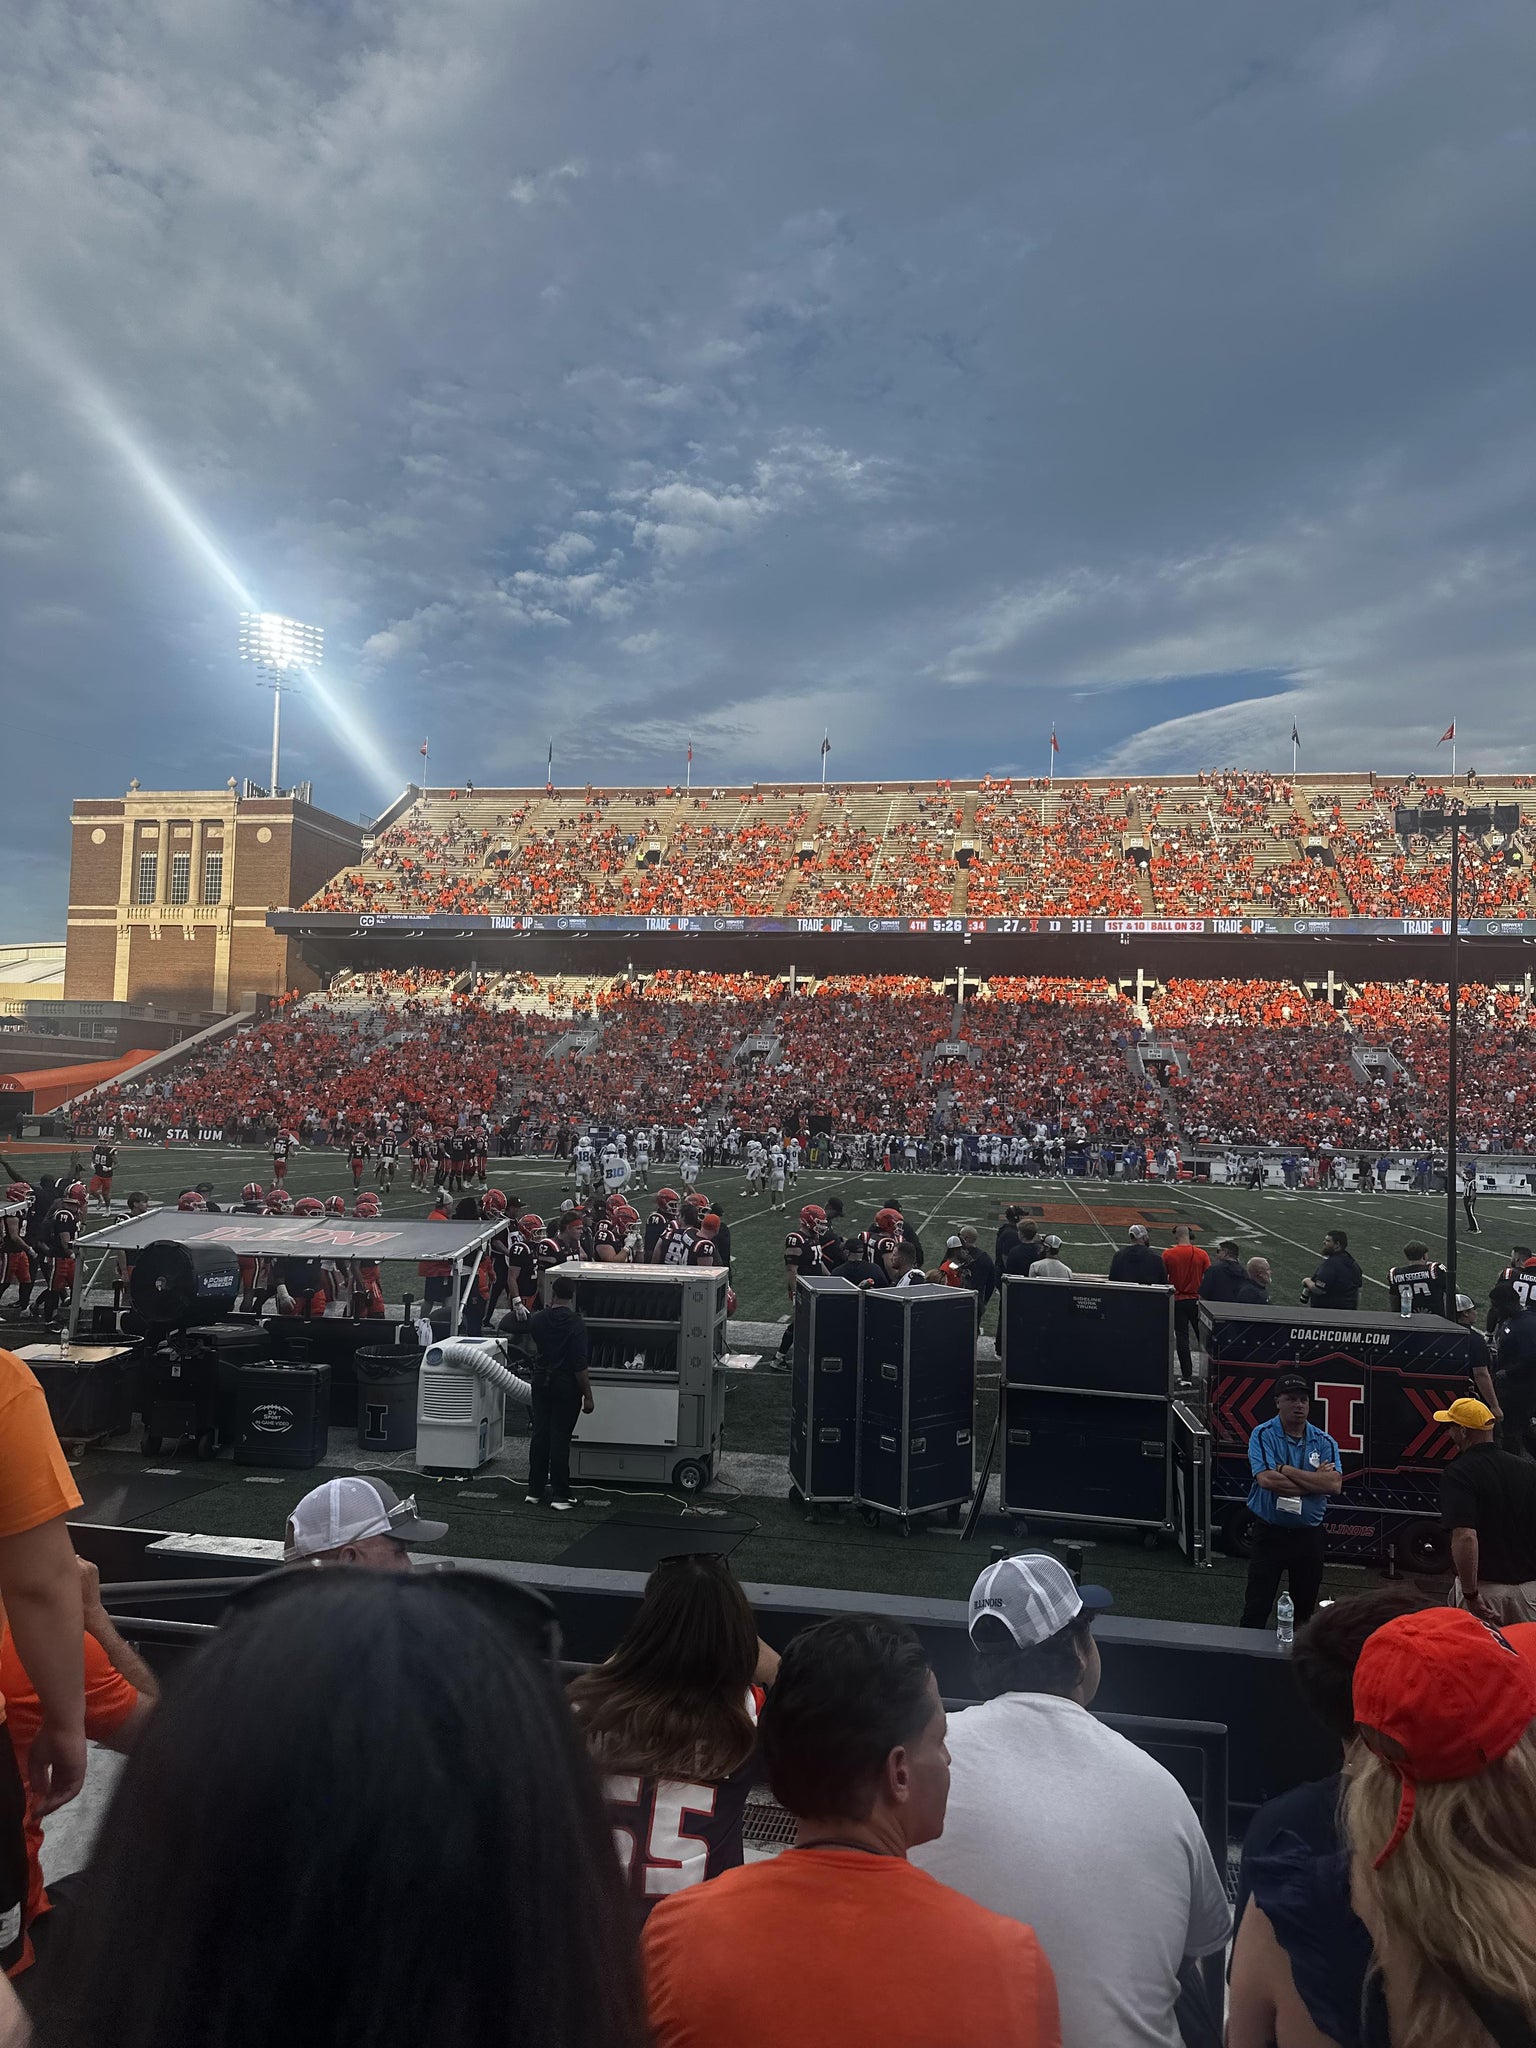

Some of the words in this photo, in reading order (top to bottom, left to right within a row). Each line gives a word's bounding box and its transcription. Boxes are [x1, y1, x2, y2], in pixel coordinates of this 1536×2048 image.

[490, 916, 516, 928] TRADE
[522, 917, 533, 928] UP
[645, 918, 671, 930] TRADE
[678, 918, 688, 930] UP
[796, 919, 824, 931] TRADE
[830, 919, 842, 931] UP
[910, 921, 926, 930] 4TH
[933, 920, 962, 931] 5:26
[1108, 922, 1122, 930] 1ST
[1134, 922, 1145, 930] 10
[1151, 922, 1174, 930] BALL
[1175, 922, 1187, 930] ON
[1190, 922, 1202, 930] 32
[1212, 920, 1242, 932] TRADE
[1251, 920, 1264, 932] UP
[1402, 921, 1433, 934] TRADE
[166, 1128, 222, 1140] STAIUM
[578, 1151, 589, 1161] 18
[513, 1246, 524, 1255] 37
[1394, 1274, 1405, 1283] VON
[1290, 1328, 1390, 1344] COACHCOMM.COM
[365, 1403, 388, 1440] I
[1315, 1382, 1364, 1454] I
[974, 1598, 1002, 1610] ILLINOIS
